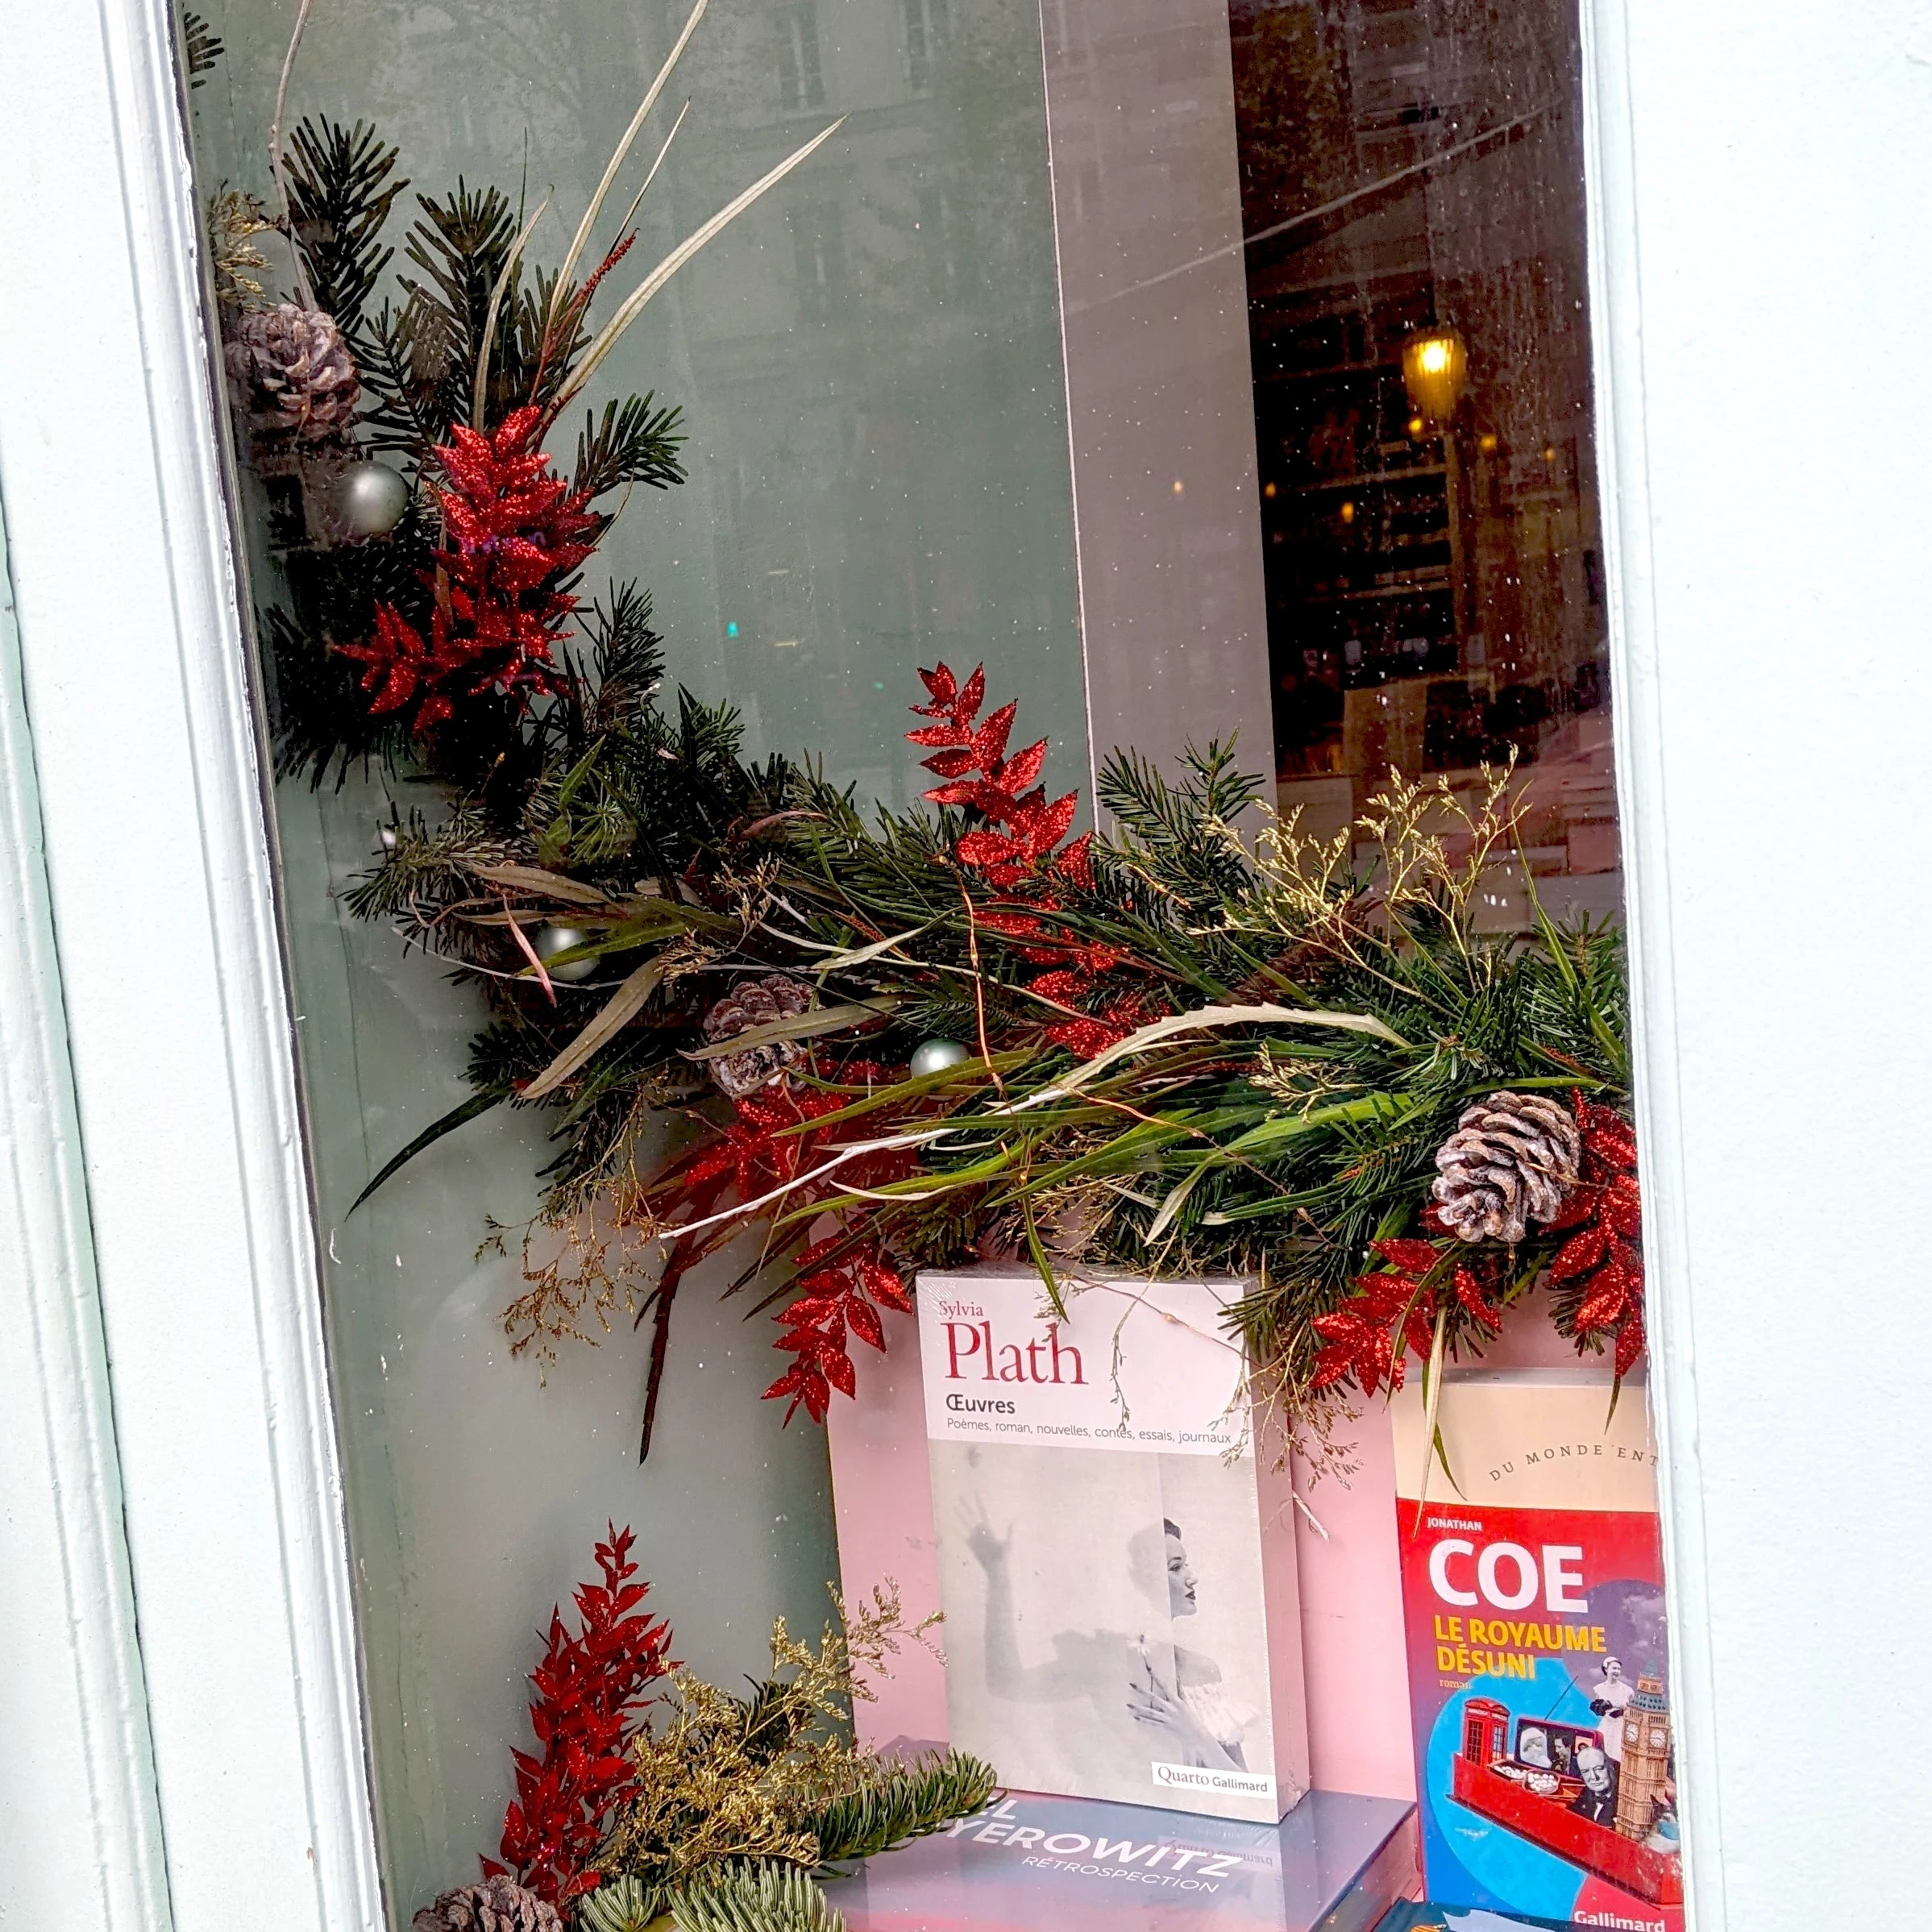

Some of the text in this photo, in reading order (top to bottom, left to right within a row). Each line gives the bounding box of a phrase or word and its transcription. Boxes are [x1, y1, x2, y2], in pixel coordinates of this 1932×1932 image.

[939, 1300, 984, 1319] Sylvia
[940, 1320, 1089, 1385] Plath
[945, 1394, 1016, 1414] Œuvres
[947, 1418, 1232, 1444] Poèmes, roman, nouvelles, contes, essais, journaux
[1490, 1444, 1658, 1481] DU MONDE ENT
[1427, 1517, 1483, 1531] JONATHAN
[1429, 1538, 1589, 1614] COE
[1434, 1614, 1607, 1653] LE ROYAUME
[1437, 1641, 1536, 1680] DÉSUNI
[1439, 1679, 1472, 1689] roman
[1157, 1766, 1268, 1793] Quarto Gallimard
[1574, 1910, 1666, 1932] Gallimard
